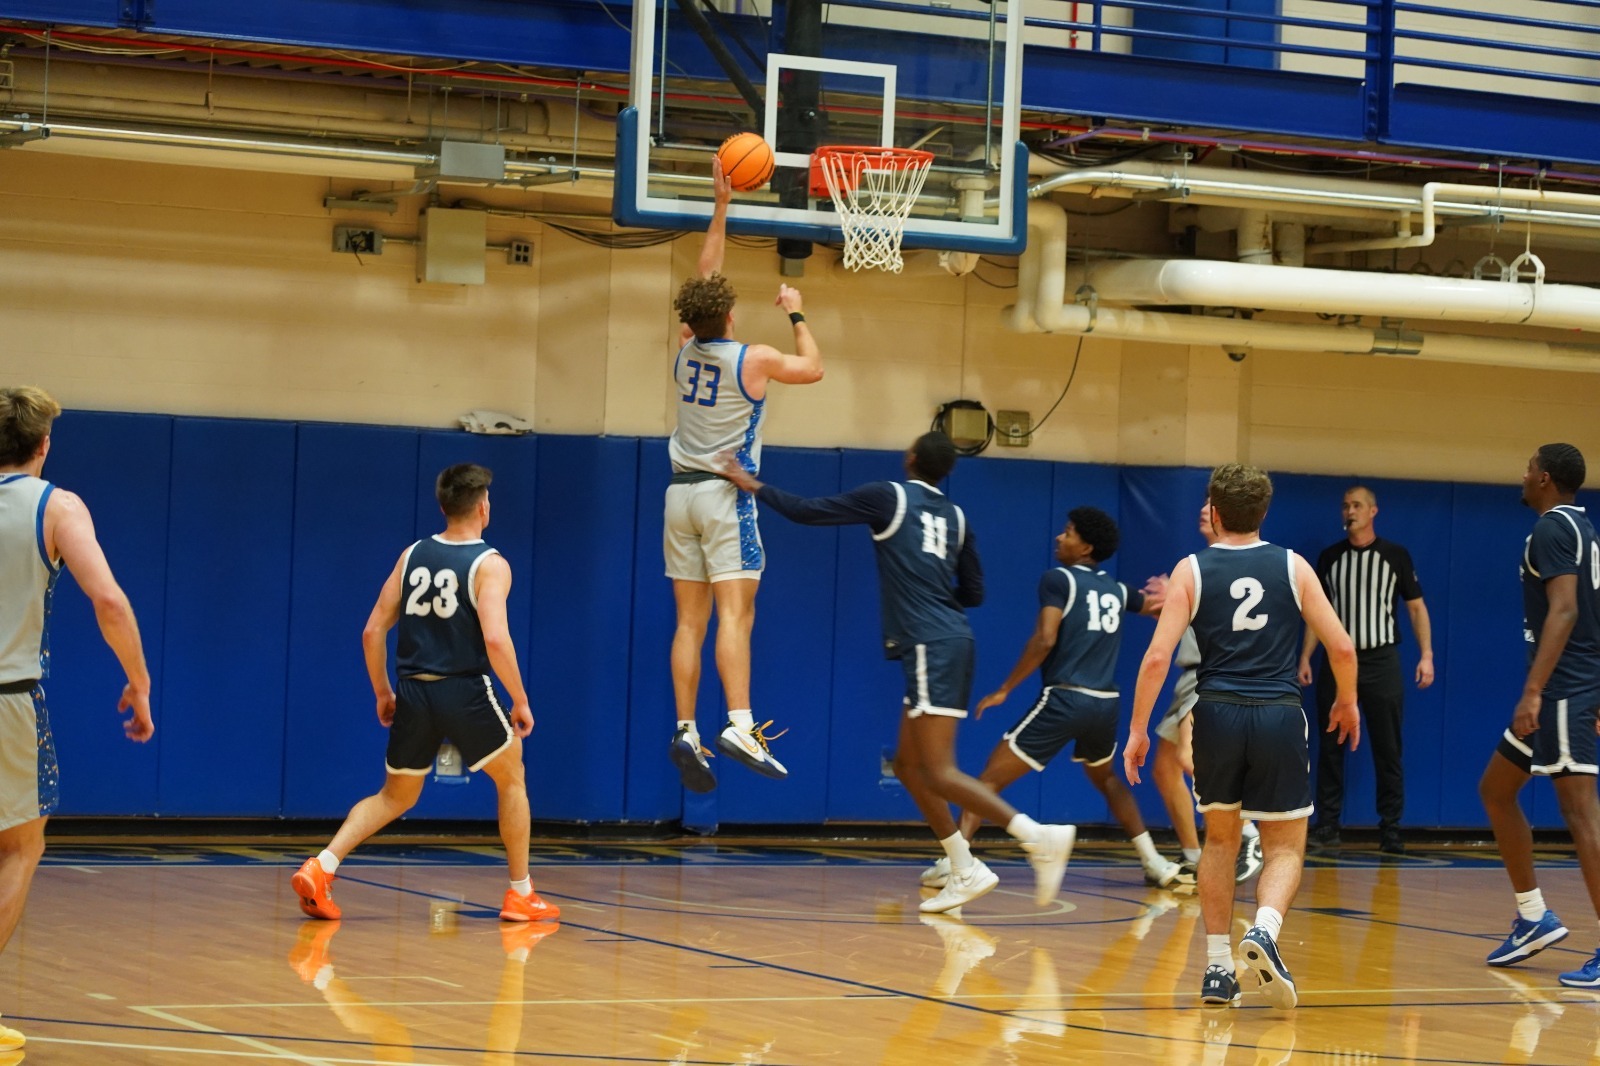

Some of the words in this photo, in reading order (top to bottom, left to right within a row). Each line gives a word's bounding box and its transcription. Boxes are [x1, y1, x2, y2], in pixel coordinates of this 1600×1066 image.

[682, 359, 721, 408] 33
[920, 510, 948, 560] 11
[405, 566, 459, 619] 23
[1086, 589, 1121, 634] 13
[1229, 576, 1269, 632] 2
